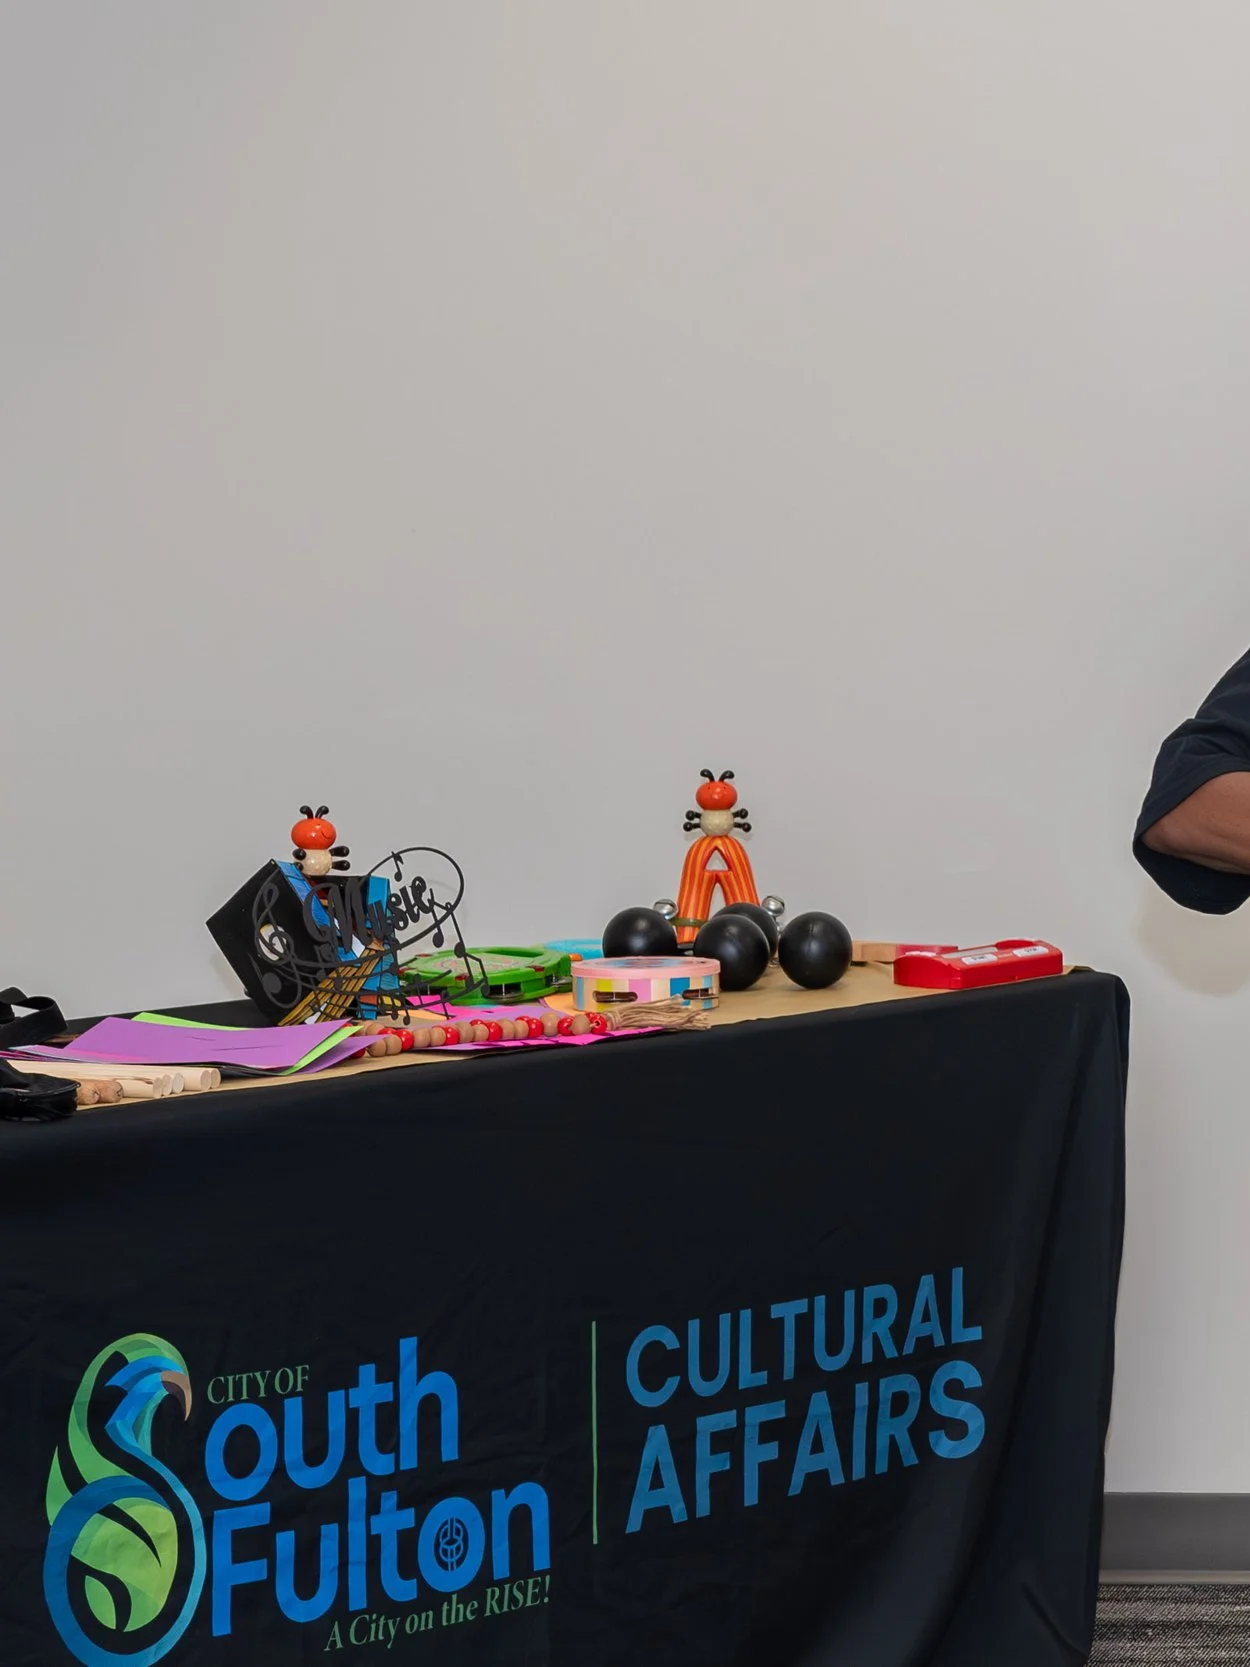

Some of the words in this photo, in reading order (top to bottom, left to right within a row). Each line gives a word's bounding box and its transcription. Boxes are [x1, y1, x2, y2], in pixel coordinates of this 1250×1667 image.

[206, 1369, 272, 1405] CITY
[273, 1364, 310, 1396] OF
[625, 1266, 983, 1408] CULTURAL
[624, 1360, 986, 1535] AFFAIRS
[211, 1475, 551, 1638] Fulton
[323, 1620, 344, 1652] A
[349, 1612, 401, 1649] City
[404, 1609, 435, 1635] on
[441, 1592, 479, 1627] the
[483, 1574, 551, 1618] RISE!
